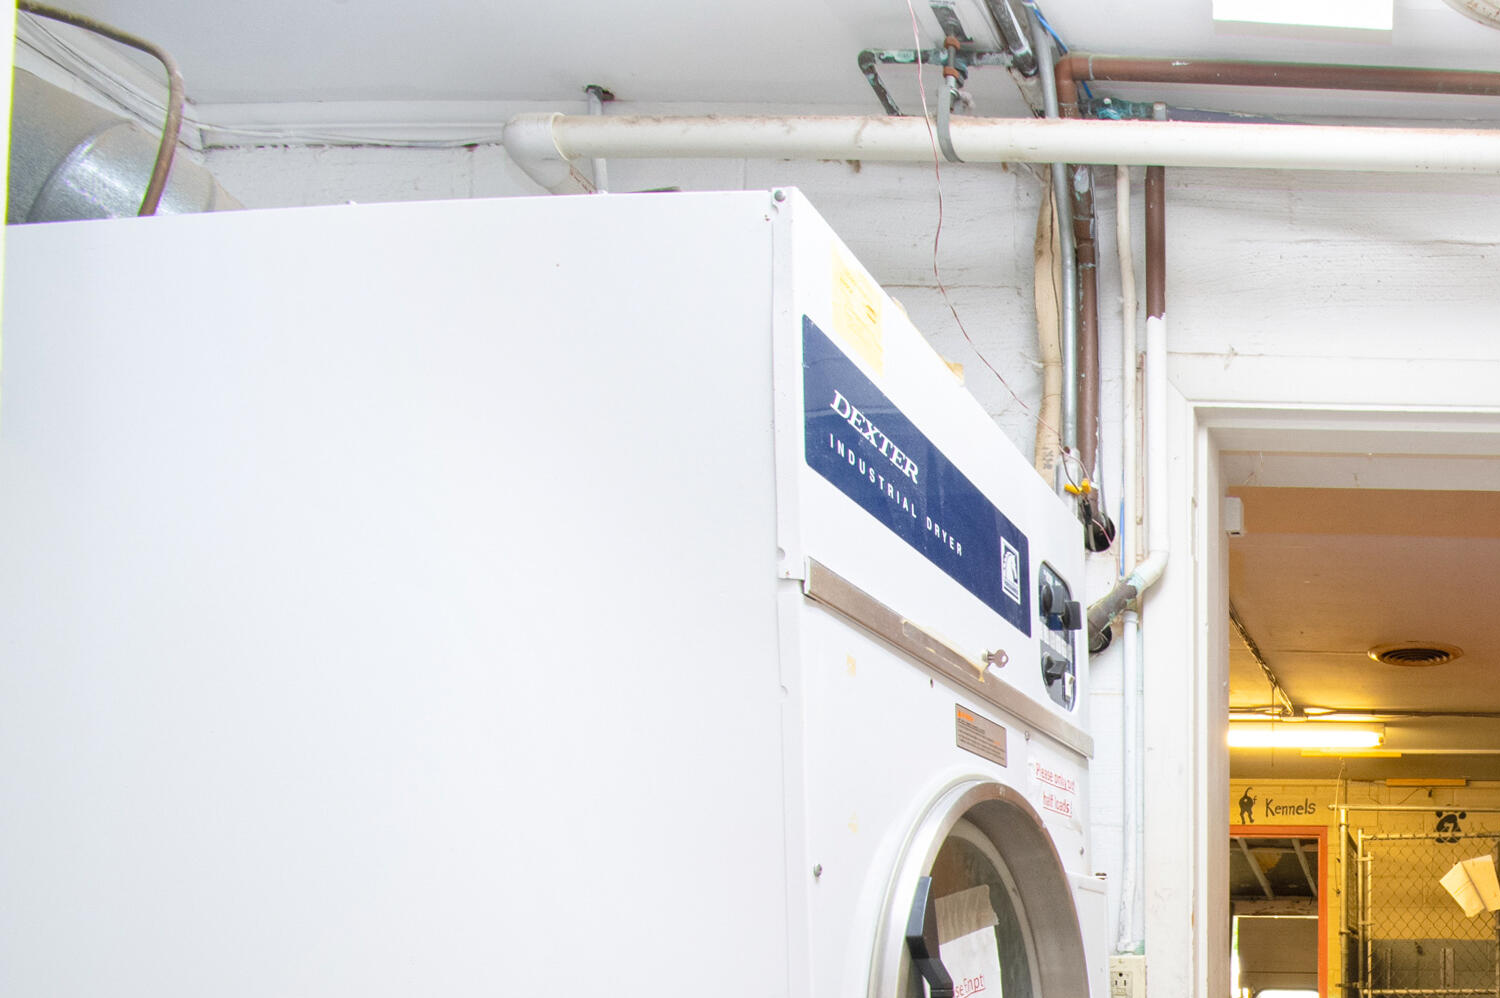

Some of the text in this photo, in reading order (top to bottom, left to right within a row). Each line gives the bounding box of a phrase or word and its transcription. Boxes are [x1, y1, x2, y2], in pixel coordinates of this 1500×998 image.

[829, 389, 919, 485] DEXTER
[829, 433, 963, 557] INDUSTRIAL DRYER
[1265, 798, 1317, 818] Kennels
